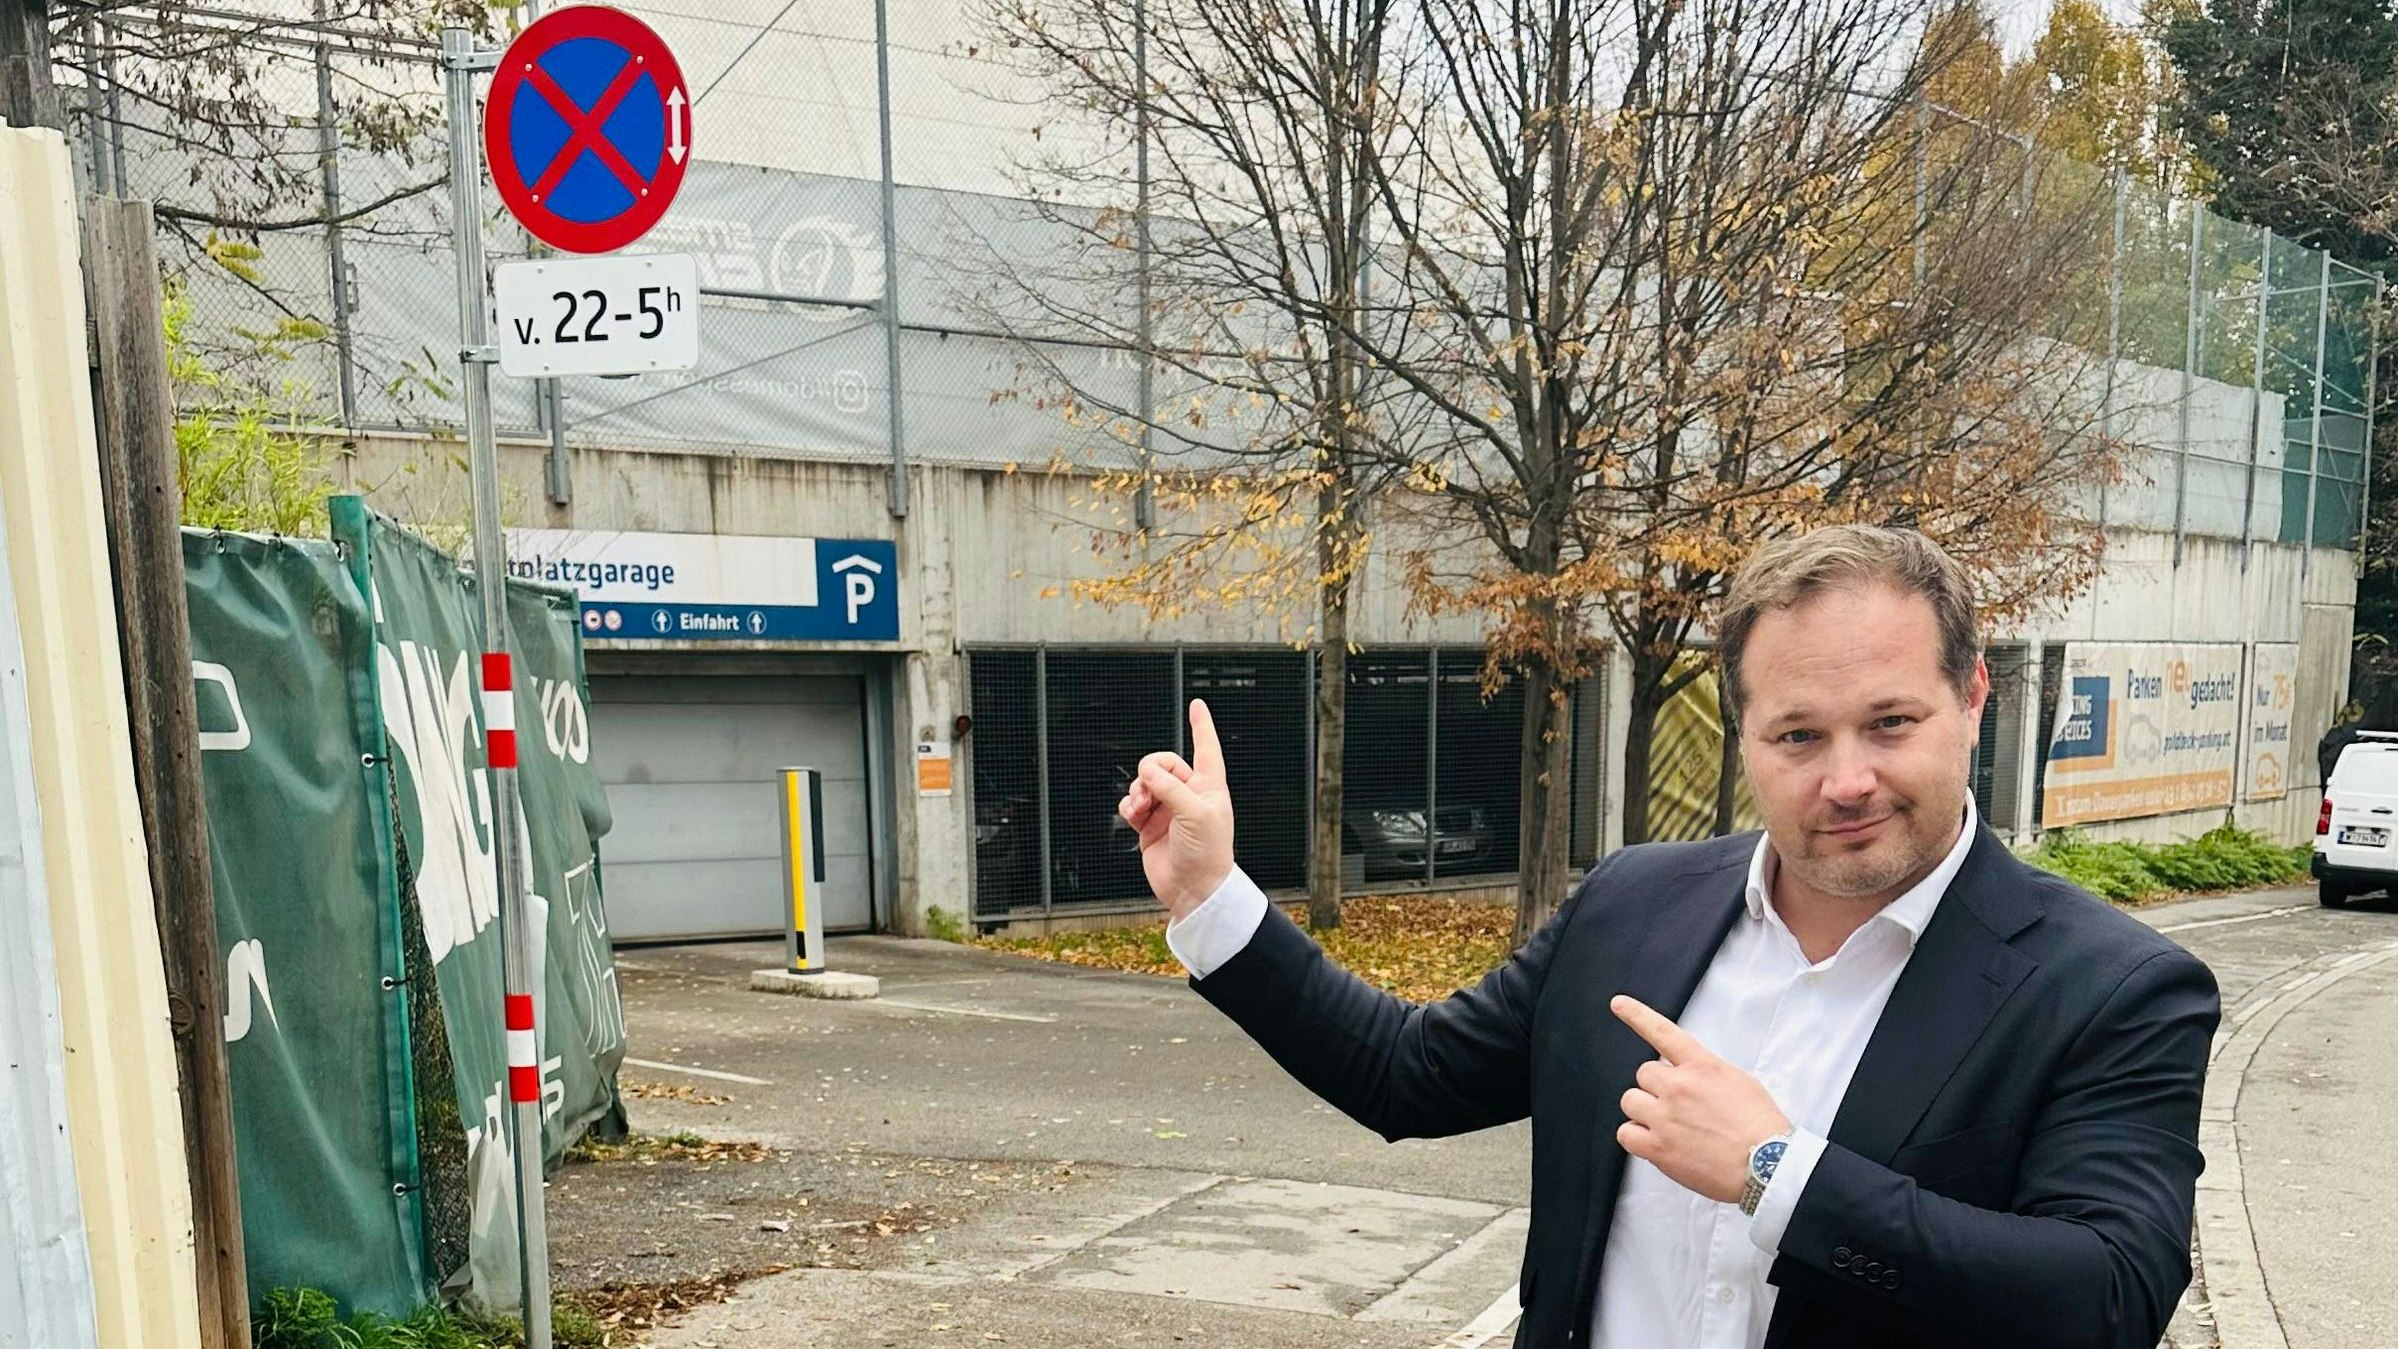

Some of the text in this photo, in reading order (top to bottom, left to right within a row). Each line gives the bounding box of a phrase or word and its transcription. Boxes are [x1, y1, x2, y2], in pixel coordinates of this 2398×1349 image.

[513, 317, 541, 345] v.
[462, 553, 675, 590] tplatzgarage
[845, 573, 875, 624] P
[679, 613, 740, 632] Einfahrt
[2127, 660, 2236, 709] Parken neu gedacht!
